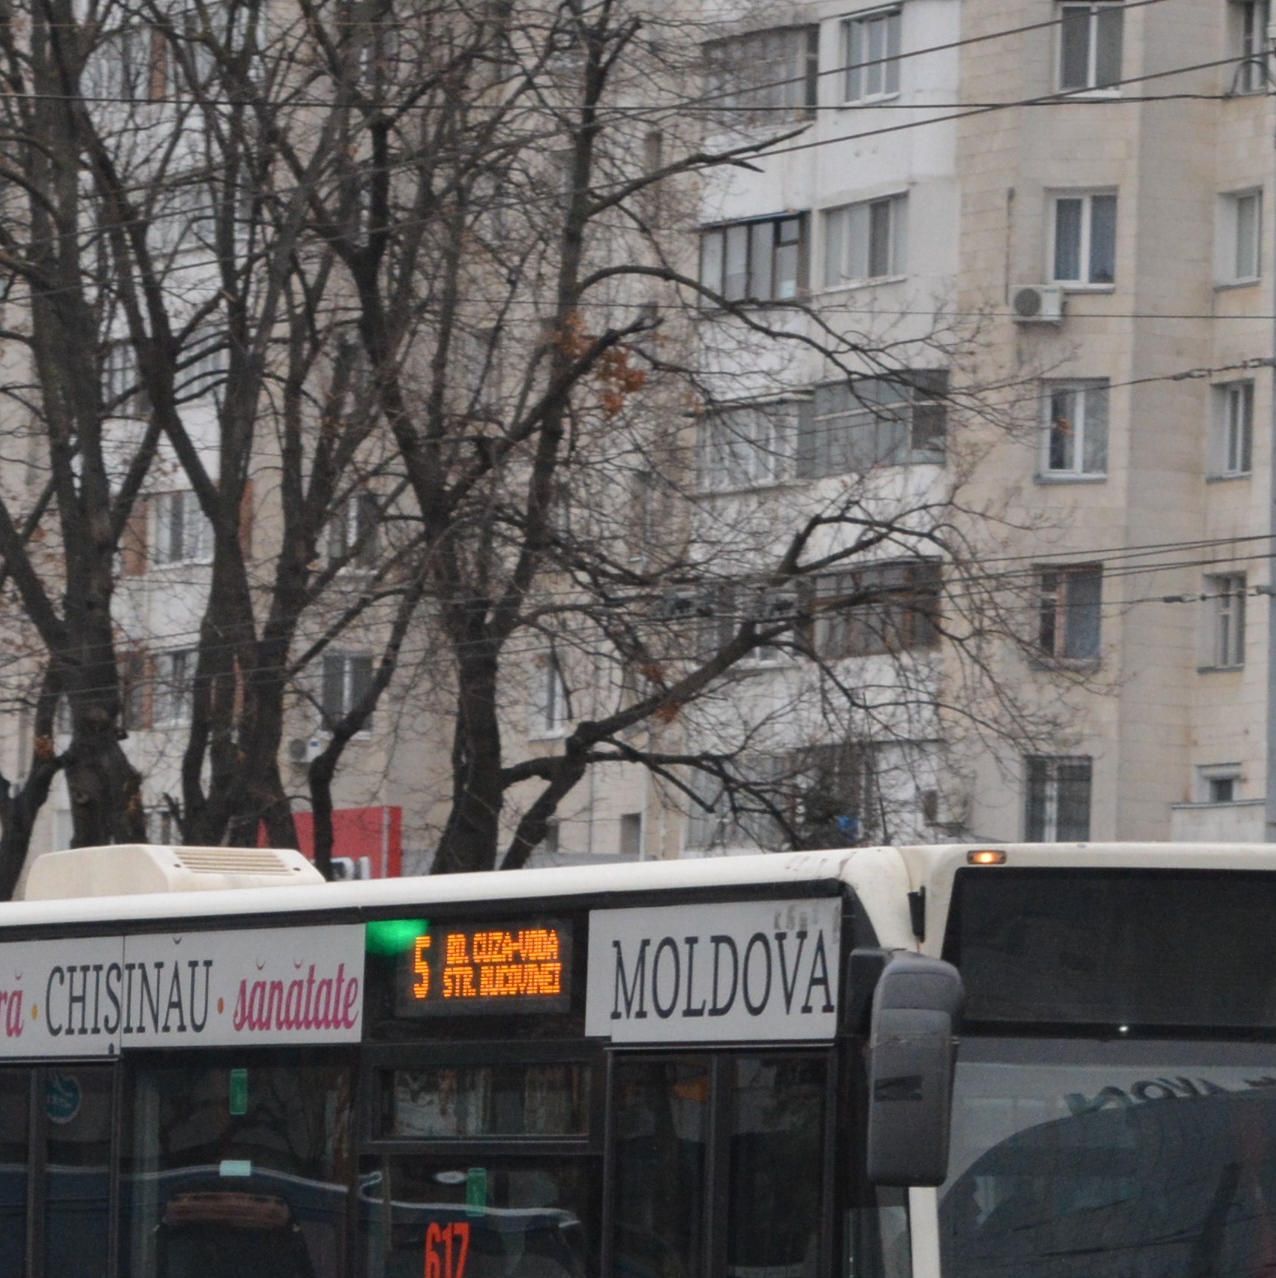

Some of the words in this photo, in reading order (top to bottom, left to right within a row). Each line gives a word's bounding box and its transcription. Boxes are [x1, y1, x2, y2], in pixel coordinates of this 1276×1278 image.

[44, 936, 214, 1054] CHIȘINĂU
[233, 957, 359, 1031] sănătate
[413, 935, 432, 999] 5
[442, 966, 477, 998] STR.
[610, 928, 835, 1020] MOLDOVA
